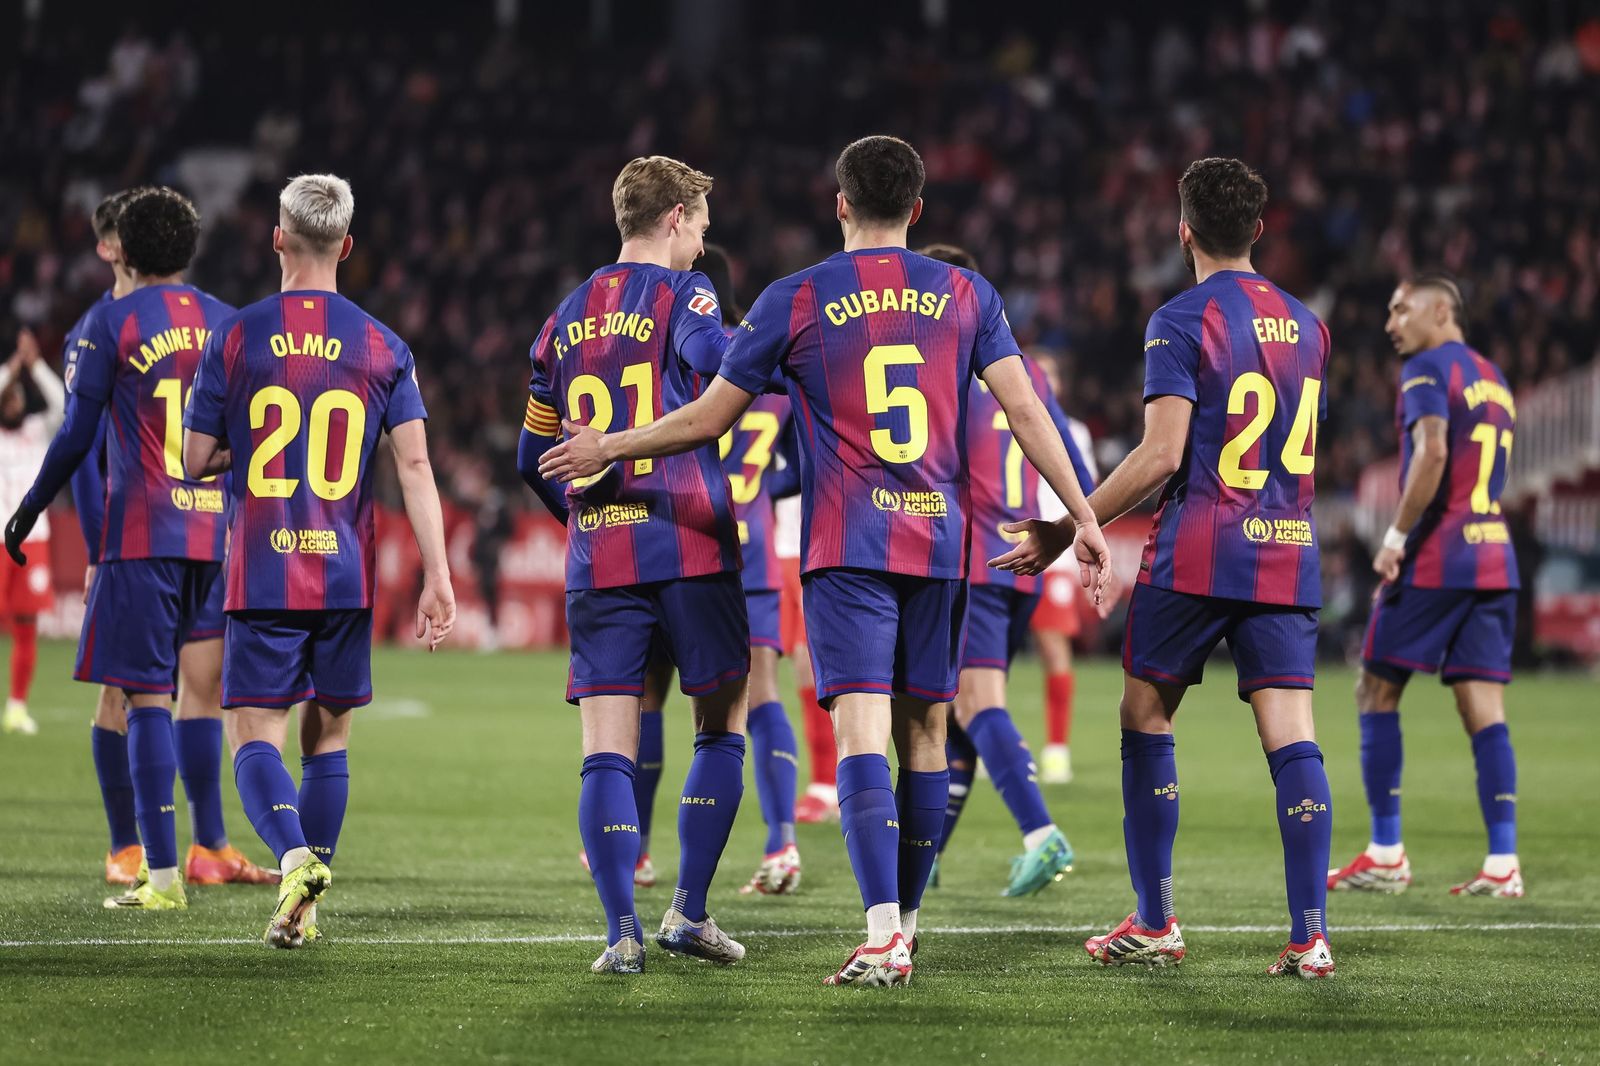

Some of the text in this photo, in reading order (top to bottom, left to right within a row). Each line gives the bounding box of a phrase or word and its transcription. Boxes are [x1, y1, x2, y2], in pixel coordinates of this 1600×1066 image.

[824, 288, 951, 326] CUBARSÍ
[553, 311, 655, 361] F. DE JONG
[1252, 317, 1299, 344] ERIC
[129, 326, 212, 374] LAMINE Y
[270, 332, 342, 361] OLMO
[863, 344, 929, 464] 5
[567, 361, 655, 488] 21
[1218, 371, 1321, 490] 24
[247, 385, 366, 500] 20
[718, 411, 780, 504] 3
[602, 503, 647, 513] UNHCR
[902, 491, 945, 502] UNHCR
[904, 502, 947, 512] ACNUR
[605, 509, 649, 524] ACNUR
[1274, 519, 1311, 532] UNHCR
[299, 530, 337, 540] UNHCR
[299, 540, 338, 550] ACNUR
[1275, 530, 1313, 542] ACNUR
